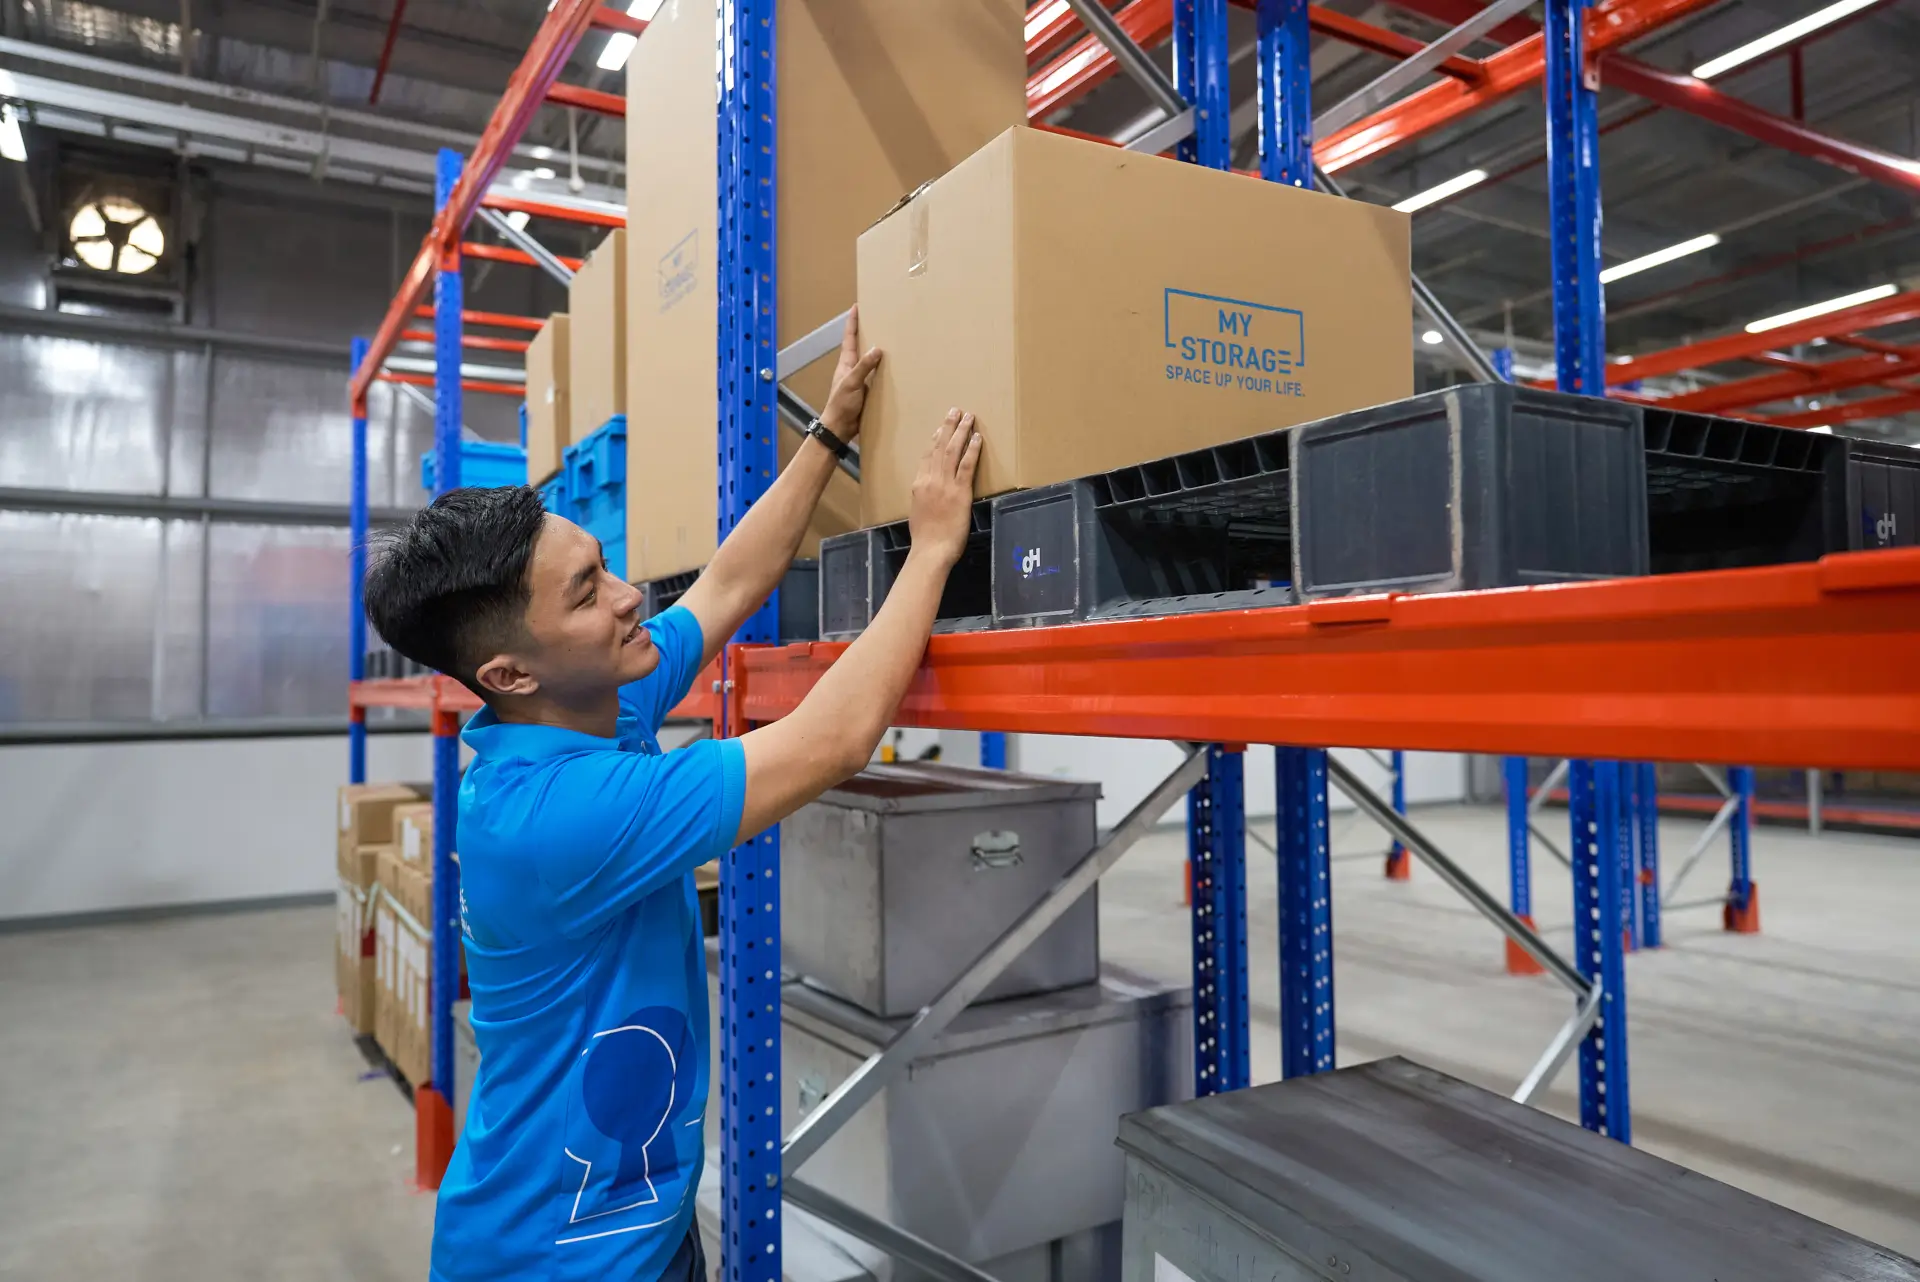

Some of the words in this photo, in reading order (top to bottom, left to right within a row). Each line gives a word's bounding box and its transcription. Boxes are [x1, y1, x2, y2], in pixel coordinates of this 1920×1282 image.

[1218, 309, 1252, 337] MY
[1181, 336, 1291, 375] STORAGE
[1166, 365, 1211, 385] SPACE
[1215, 372, 1232, 387] UP
[1237, 375, 1272, 393] YOUR
[1276, 380, 1306, 397] LIFE.
